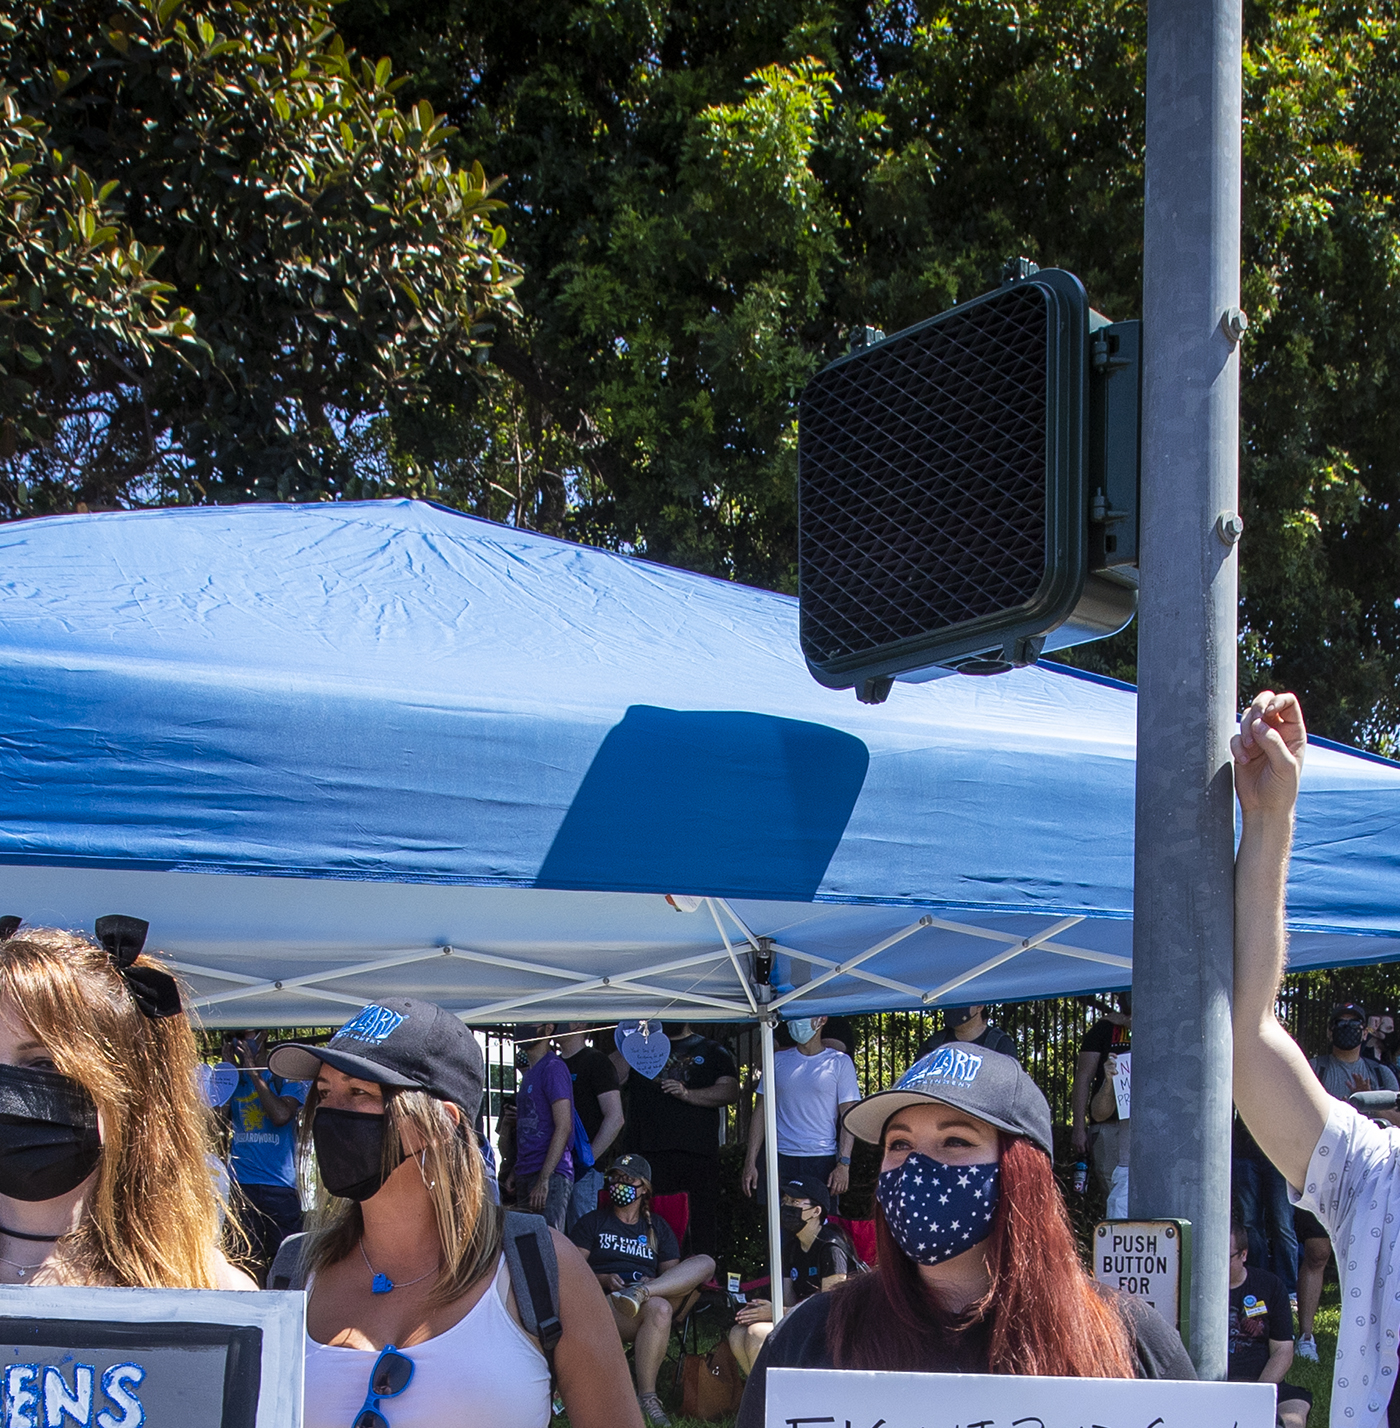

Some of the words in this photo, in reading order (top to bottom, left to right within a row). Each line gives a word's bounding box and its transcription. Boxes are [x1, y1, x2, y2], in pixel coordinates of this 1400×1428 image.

[599, 1233, 618, 1244] THE
[1113, 1235, 1157, 1254] PUSH
[600, 1241, 611, 1249] IS
[613, 1242, 654, 1260] FEMALE
[1103, 1256, 1167, 1274] BUTTON
[1119, 1277, 1150, 1294] FOR
